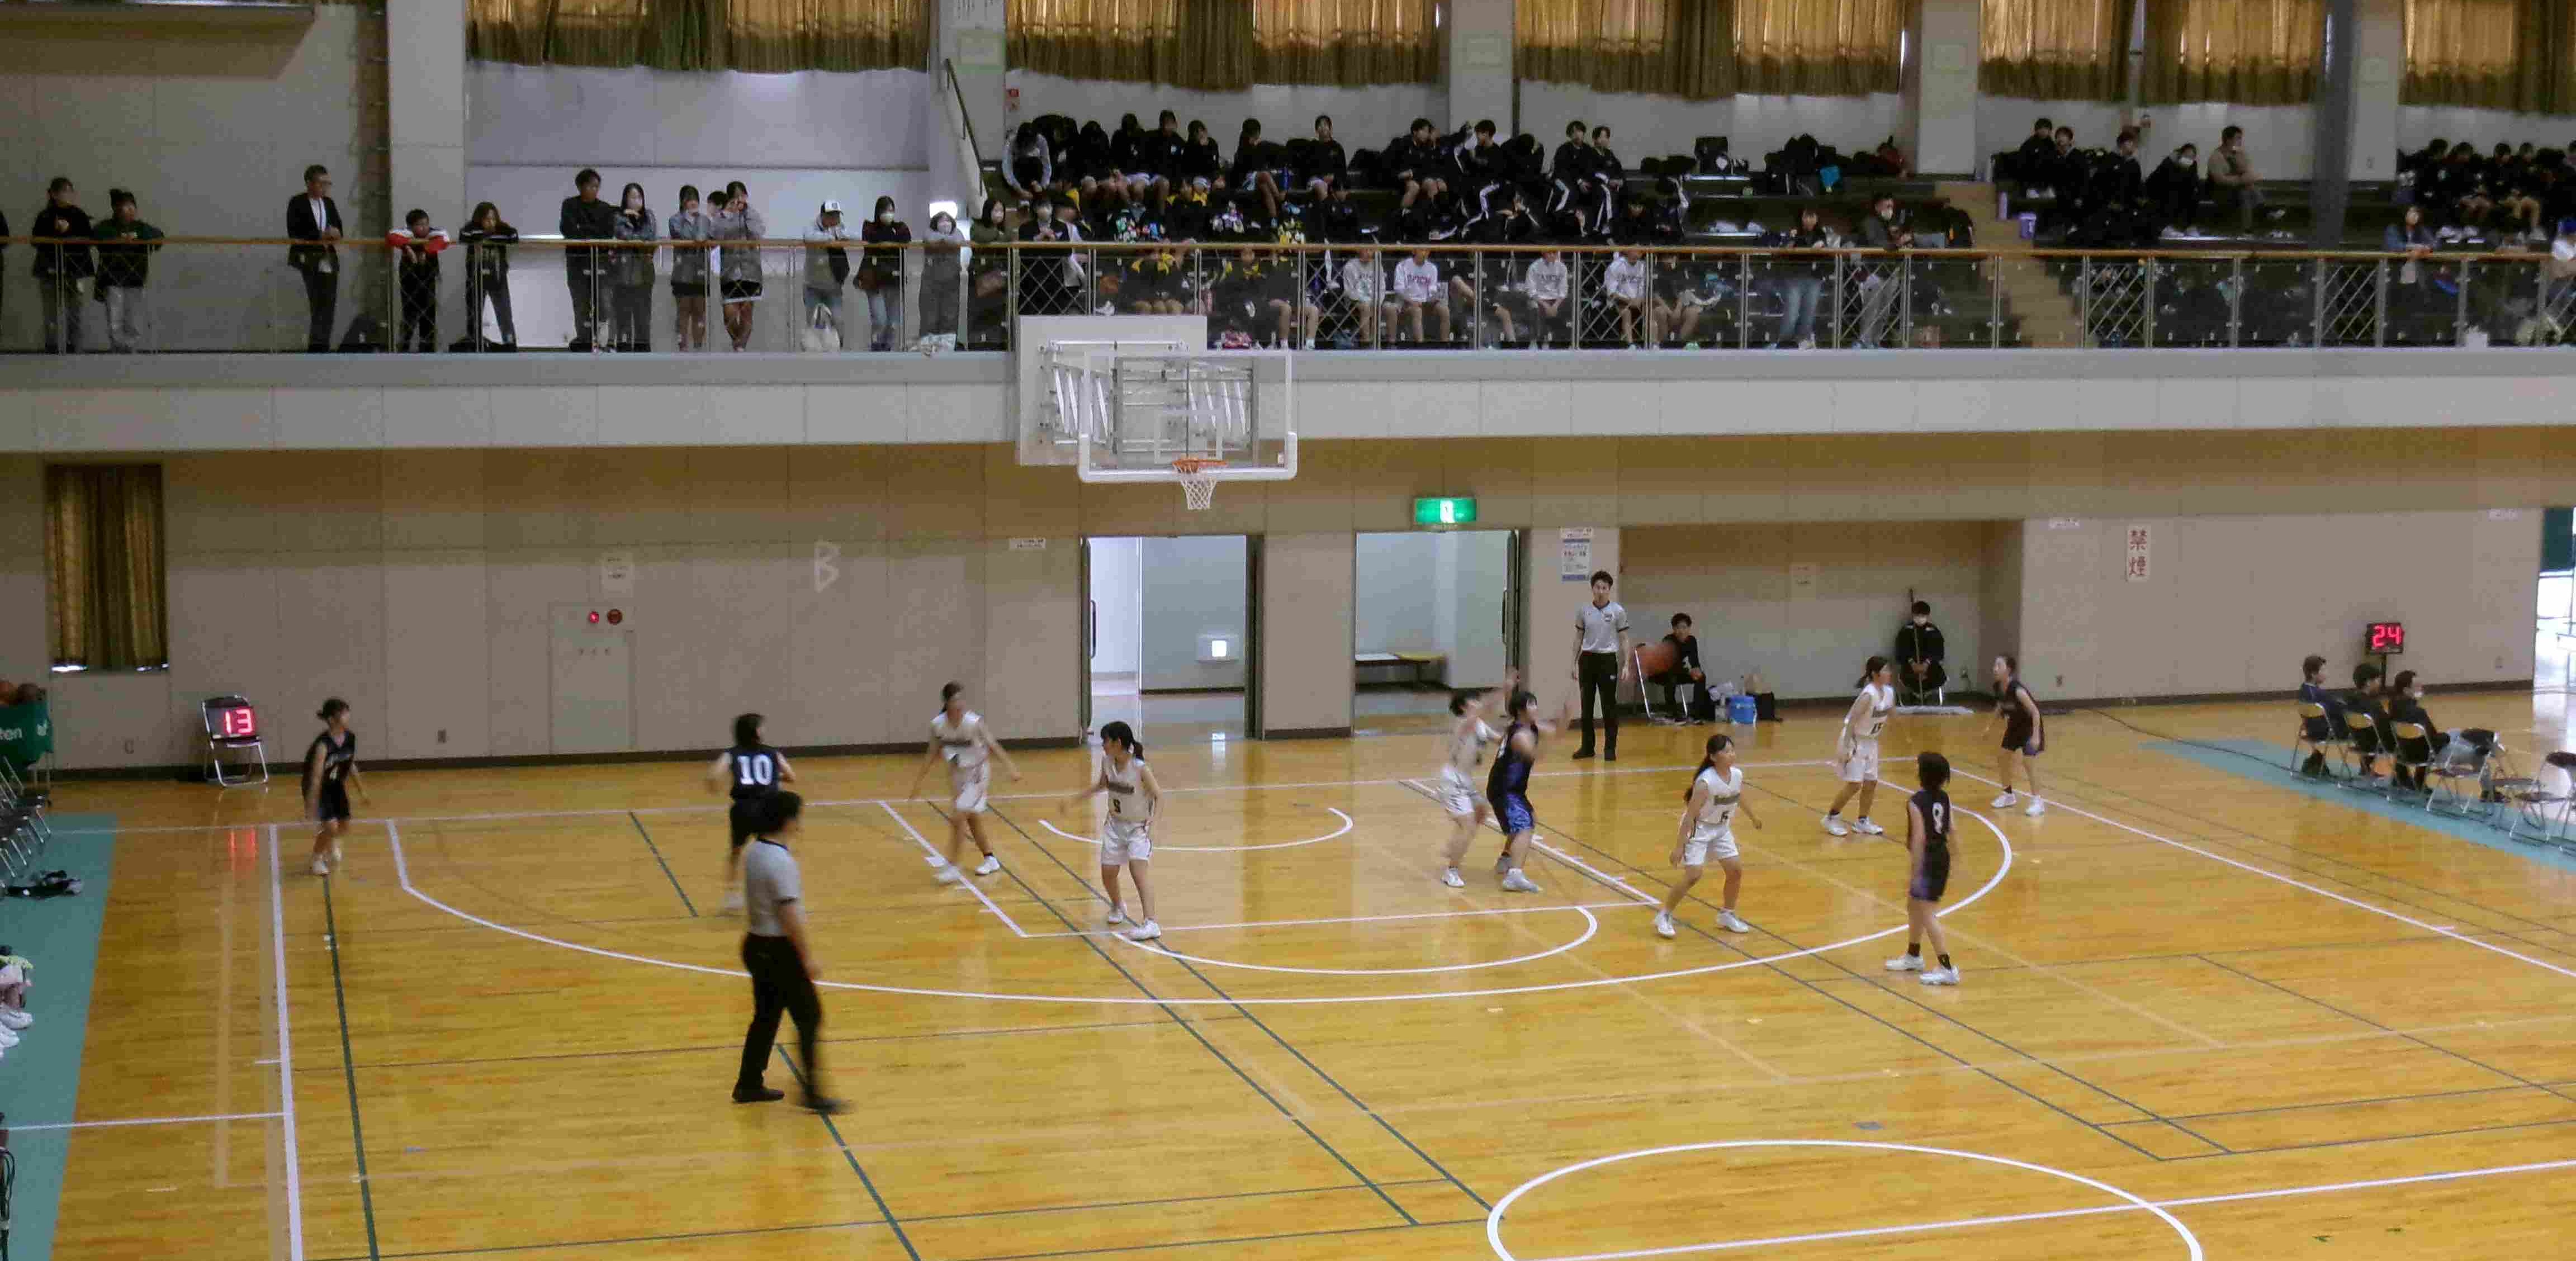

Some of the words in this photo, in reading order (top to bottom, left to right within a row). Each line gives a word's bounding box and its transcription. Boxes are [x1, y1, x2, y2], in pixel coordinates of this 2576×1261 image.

[814, 541, 841, 593] B
[2129, 530, 2147, 576] 禁煙
[2373, 625, 2400, 647] 24
[225, 709, 252, 733] 13
[737, 754, 773, 785] 10
